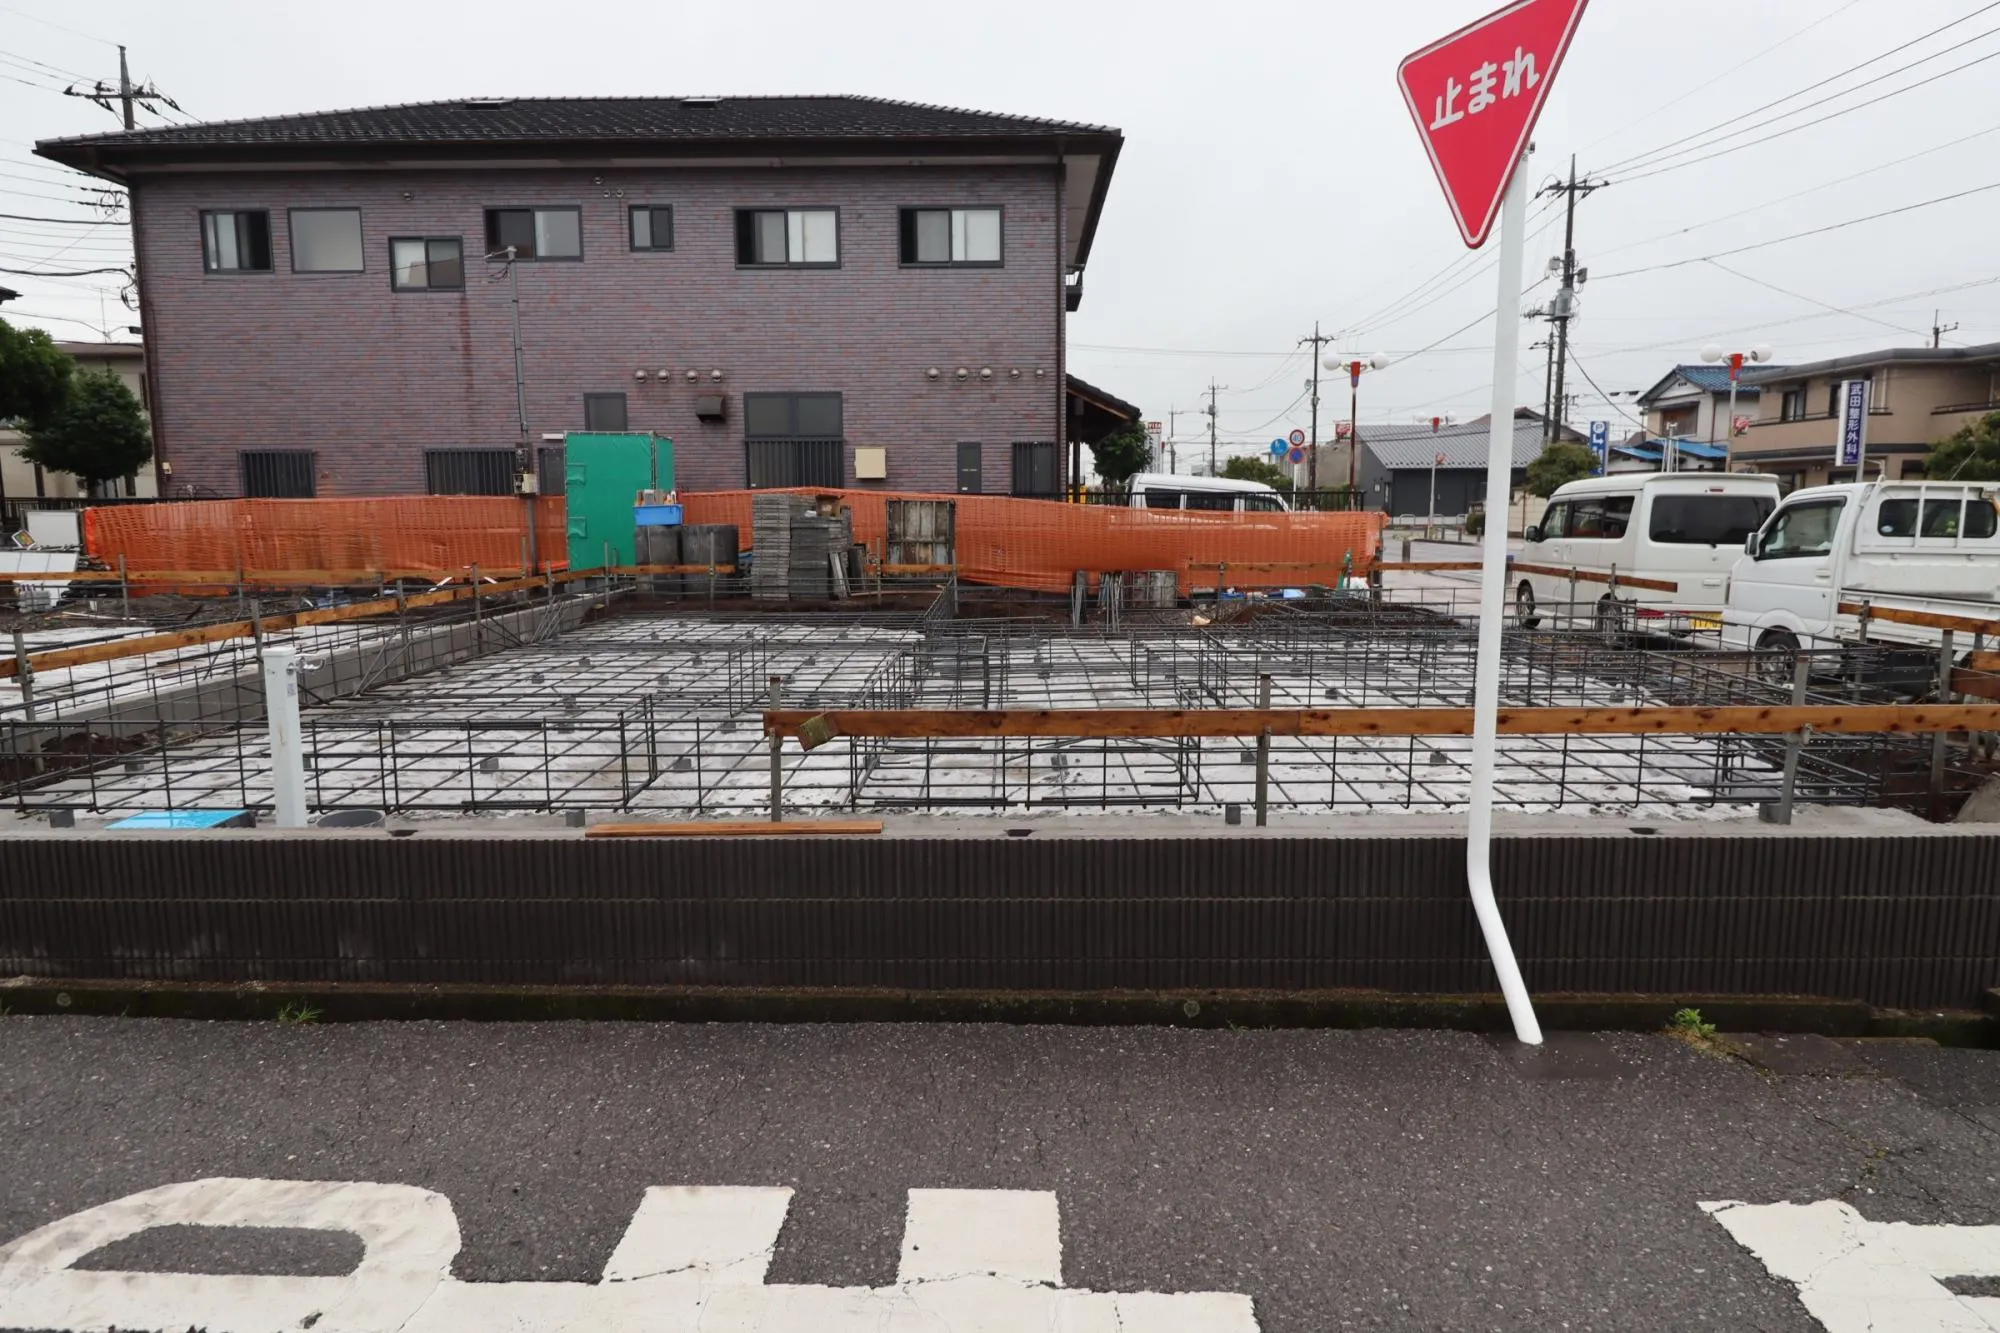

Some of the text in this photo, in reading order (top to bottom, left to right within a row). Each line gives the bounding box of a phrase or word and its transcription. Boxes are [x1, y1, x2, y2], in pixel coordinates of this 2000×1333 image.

[1429, 46, 1540, 131] 止まれ
[1846, 383, 1862, 455] 武田整形外科
